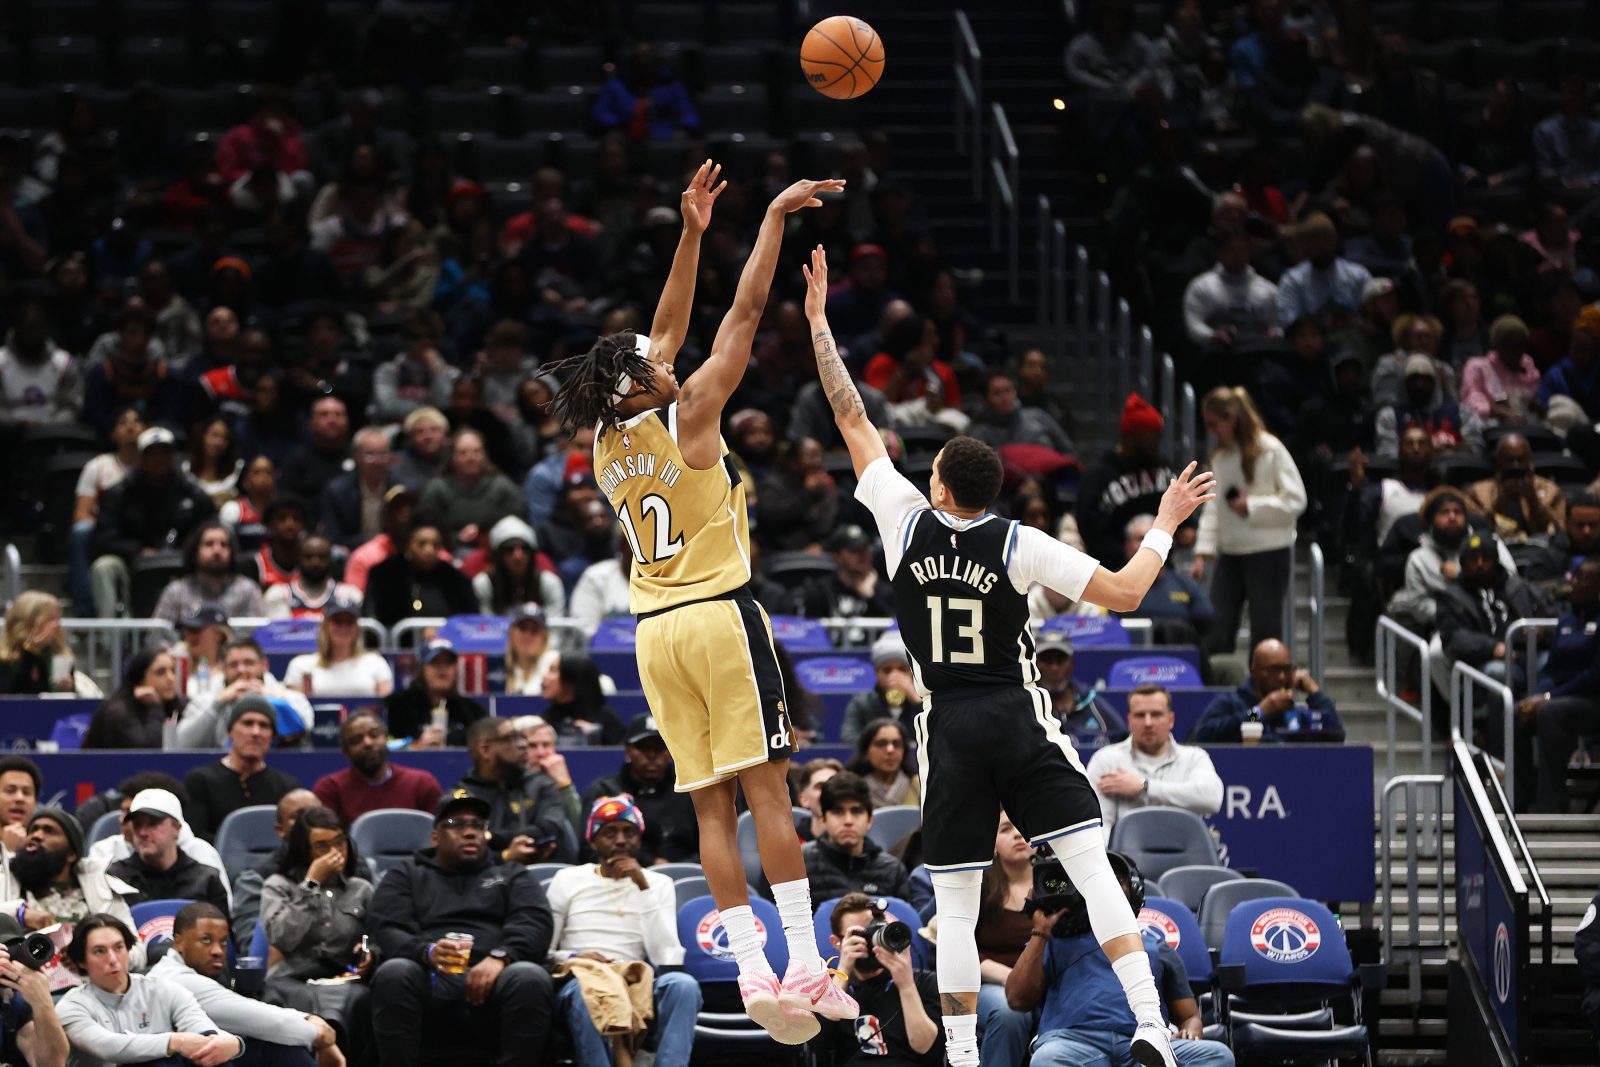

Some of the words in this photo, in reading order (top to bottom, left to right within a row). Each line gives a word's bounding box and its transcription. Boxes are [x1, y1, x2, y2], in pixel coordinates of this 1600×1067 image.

[601, 453, 656, 500] JOHNSON
[659, 459, 682, 489] III
[617, 493, 685, 565] 12
[909, 554, 999, 595] ROLLINS
[926, 595, 985, 665] 13
[1226, 785, 1286, 819] RA
[1266, 949, 1309, 961] WIZARDS
